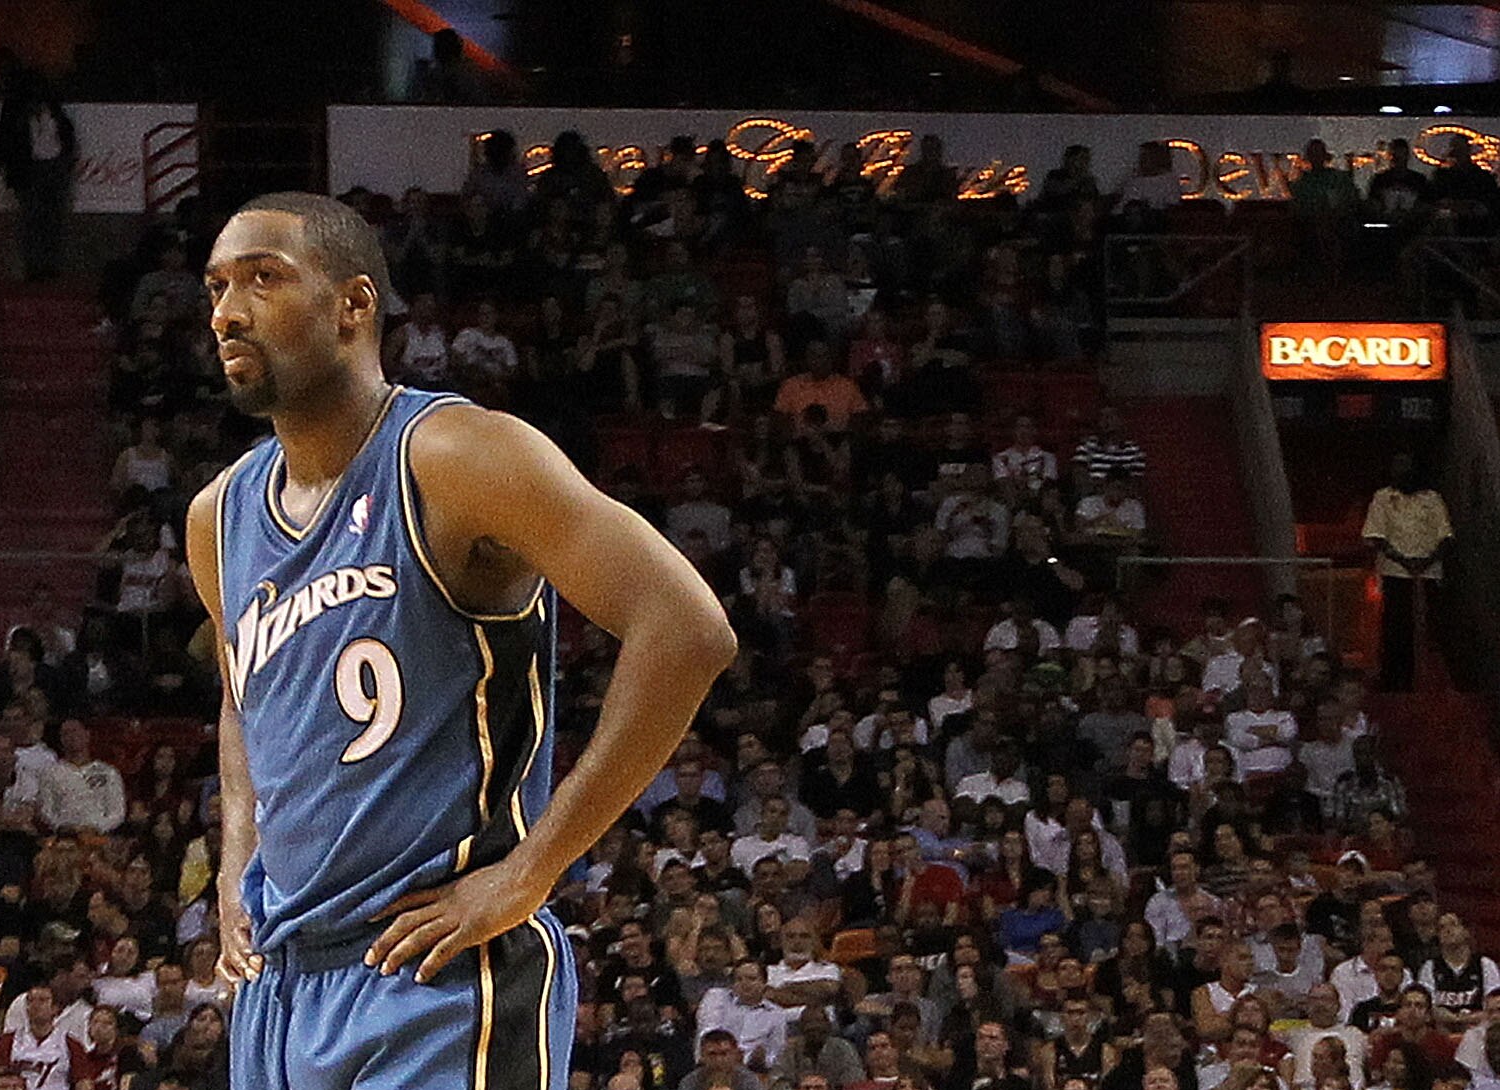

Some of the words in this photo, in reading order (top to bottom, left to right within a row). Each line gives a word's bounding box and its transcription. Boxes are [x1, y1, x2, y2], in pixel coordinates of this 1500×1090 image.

[1269, 336, 1432, 367] BACARDI
[225, 564, 398, 713] WIZARDS
[335, 637, 404, 764] 9
